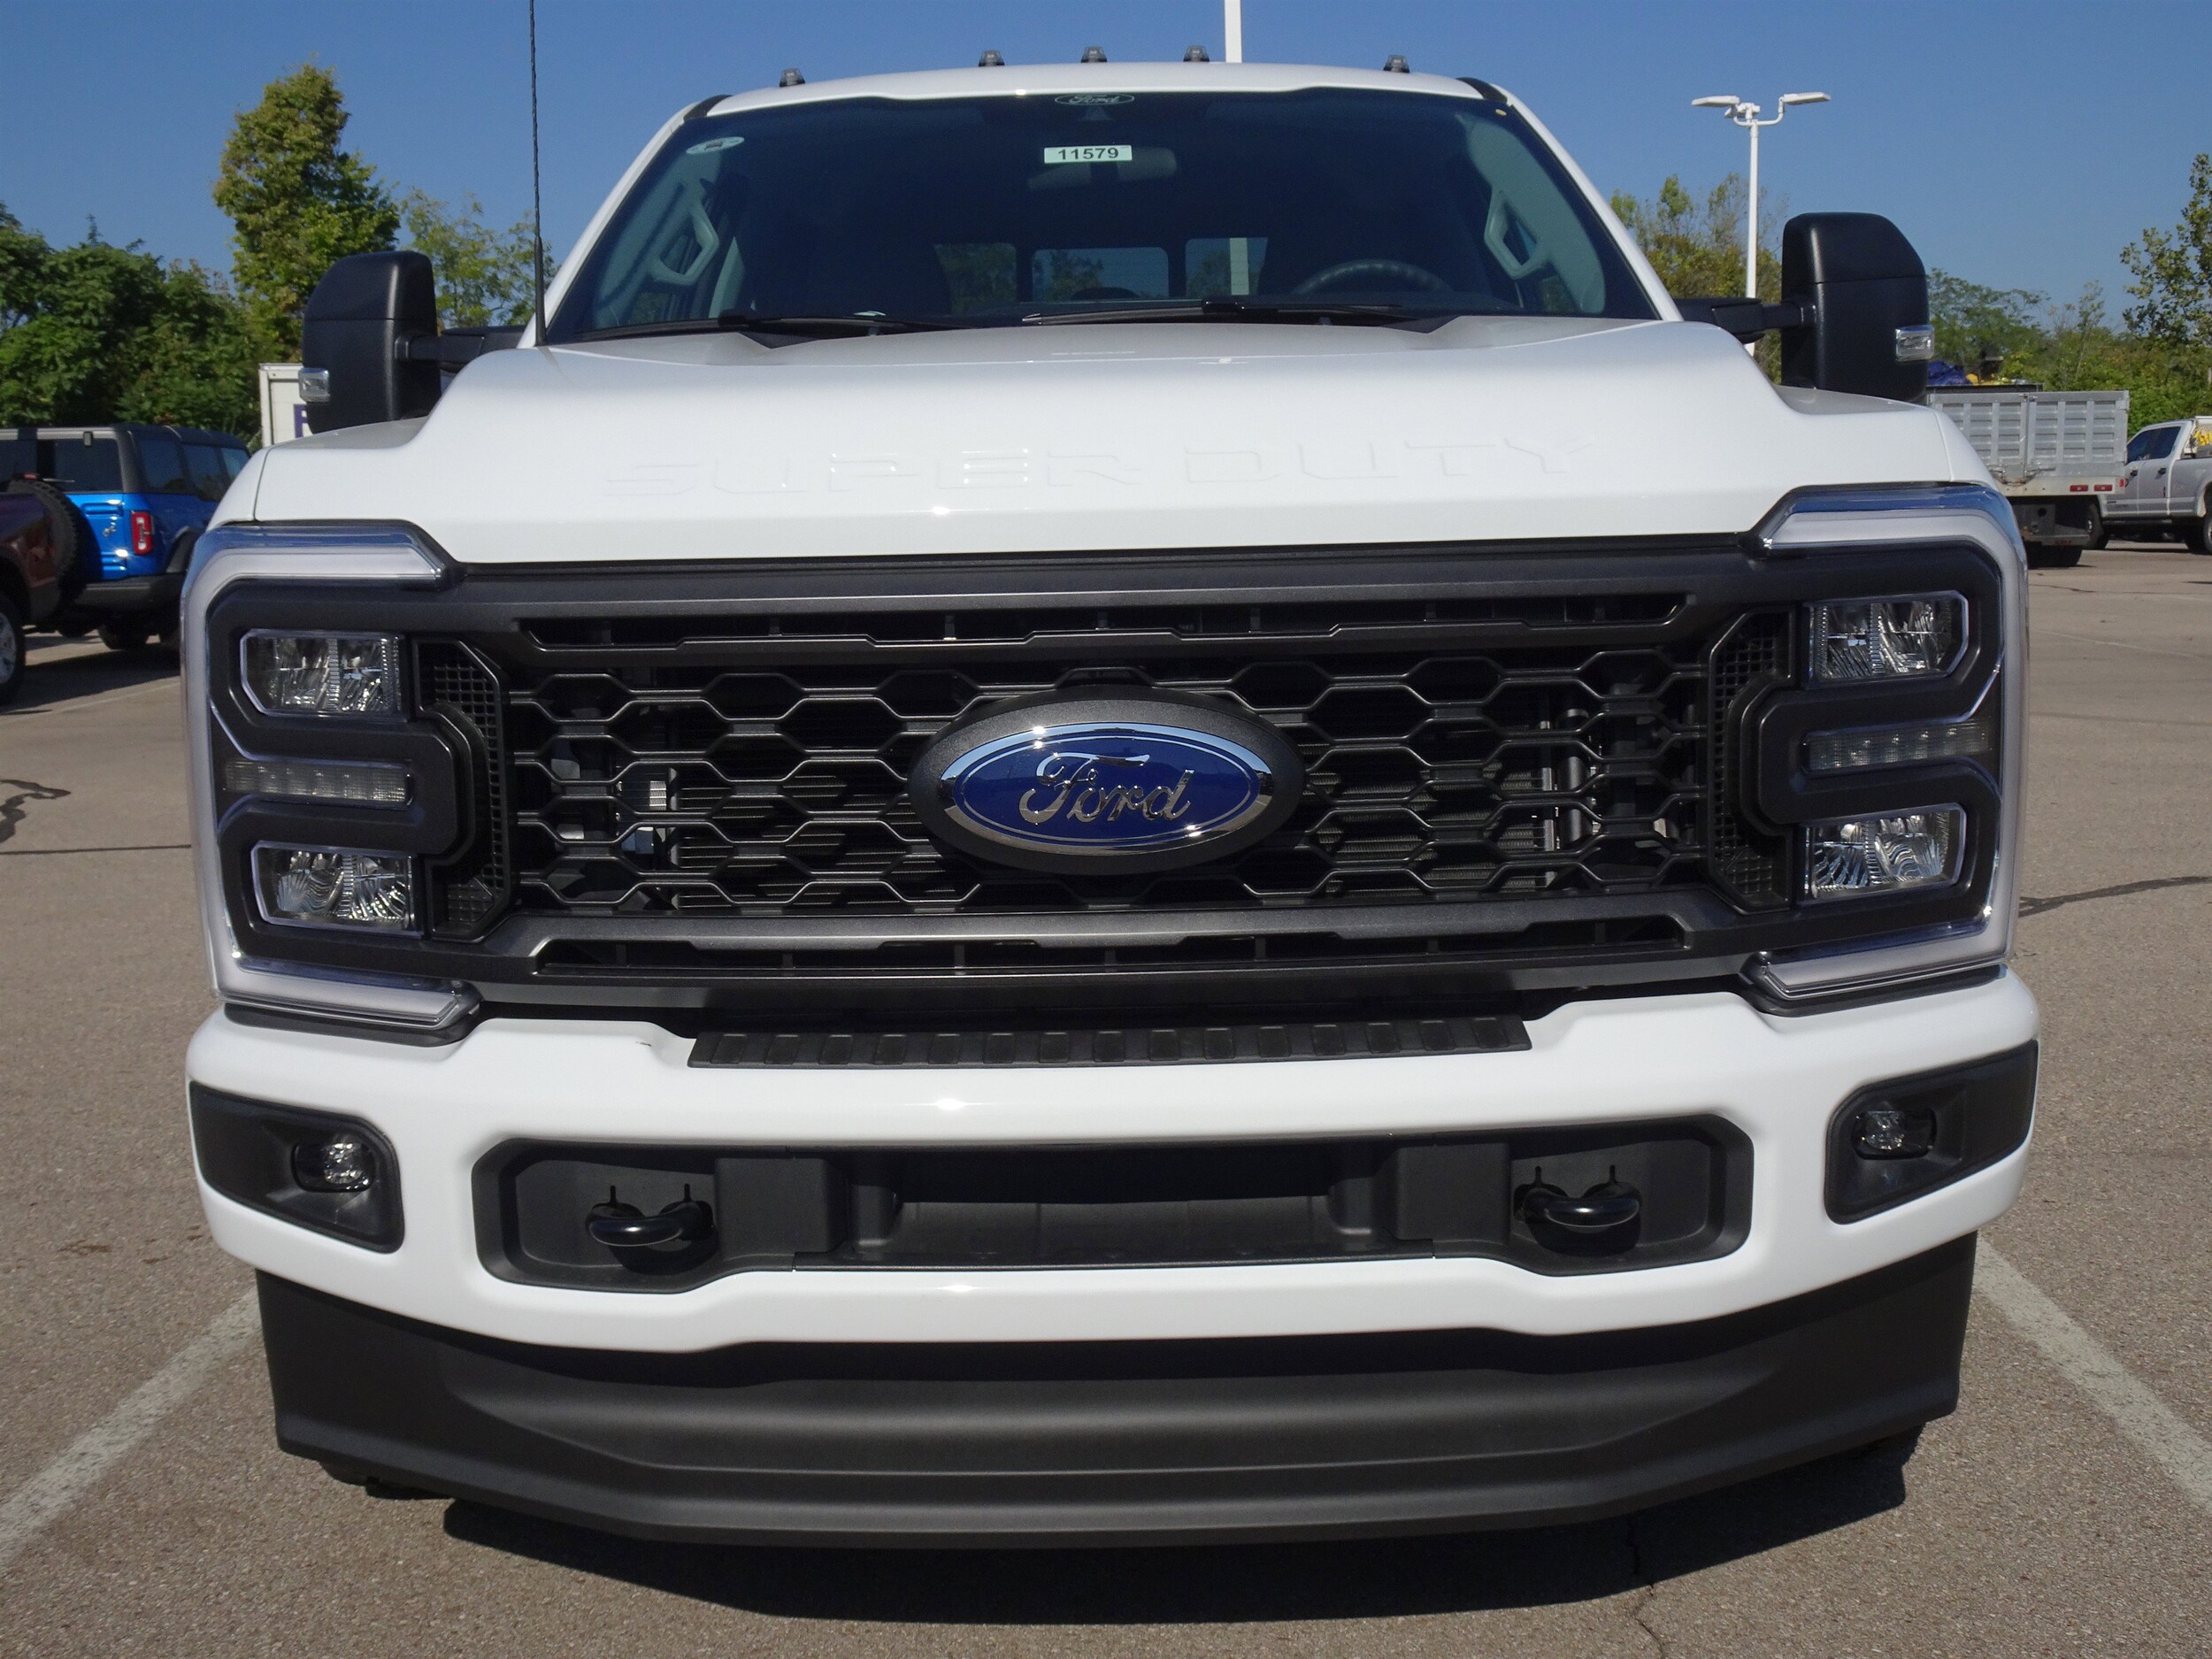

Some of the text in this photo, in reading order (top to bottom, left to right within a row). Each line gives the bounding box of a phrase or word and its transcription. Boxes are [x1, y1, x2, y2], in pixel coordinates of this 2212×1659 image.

[1069, 94, 1120, 104] Ford
[1057, 147, 1119, 160] 11579
[603, 436, 1593, 496] SUPER DUTY
[1018, 751, 1194, 825] Ford
